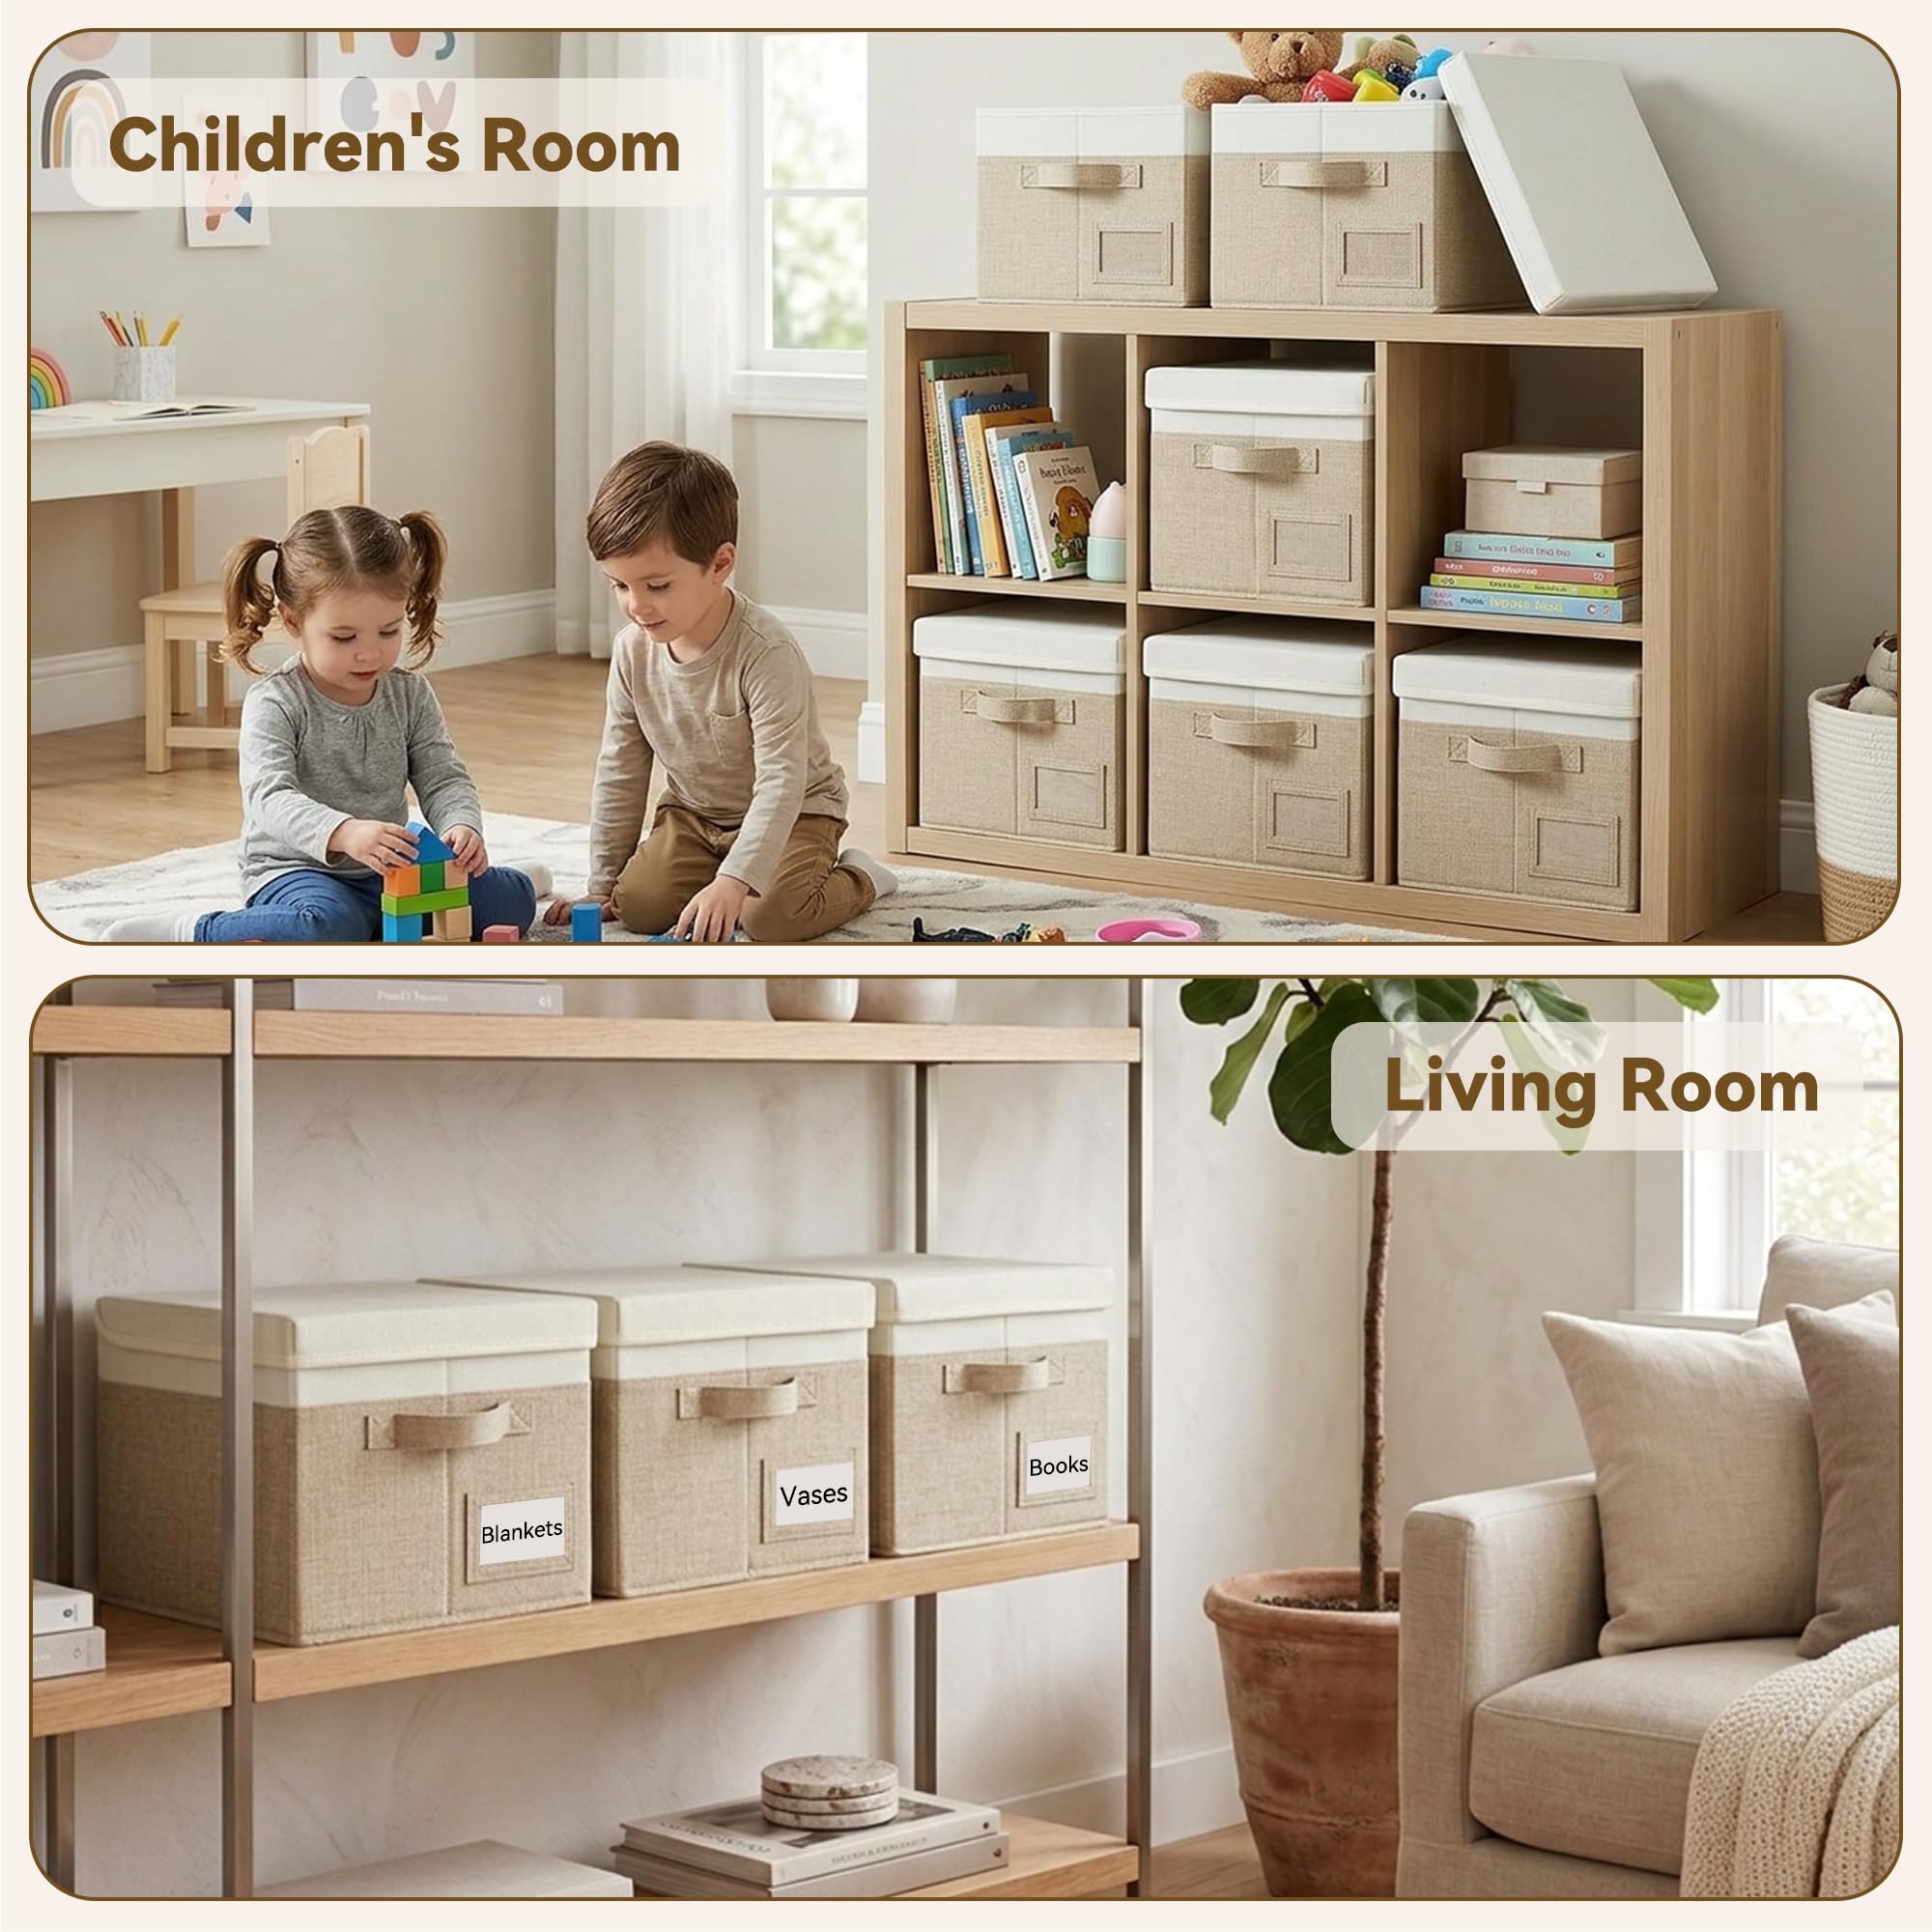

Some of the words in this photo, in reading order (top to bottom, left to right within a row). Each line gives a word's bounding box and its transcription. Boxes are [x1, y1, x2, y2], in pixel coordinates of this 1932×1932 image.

[1029, 1455, 1089, 1477] Books
[780, 1484, 848, 1508] Vases
[481, 1520, 563, 1545] Blankets
